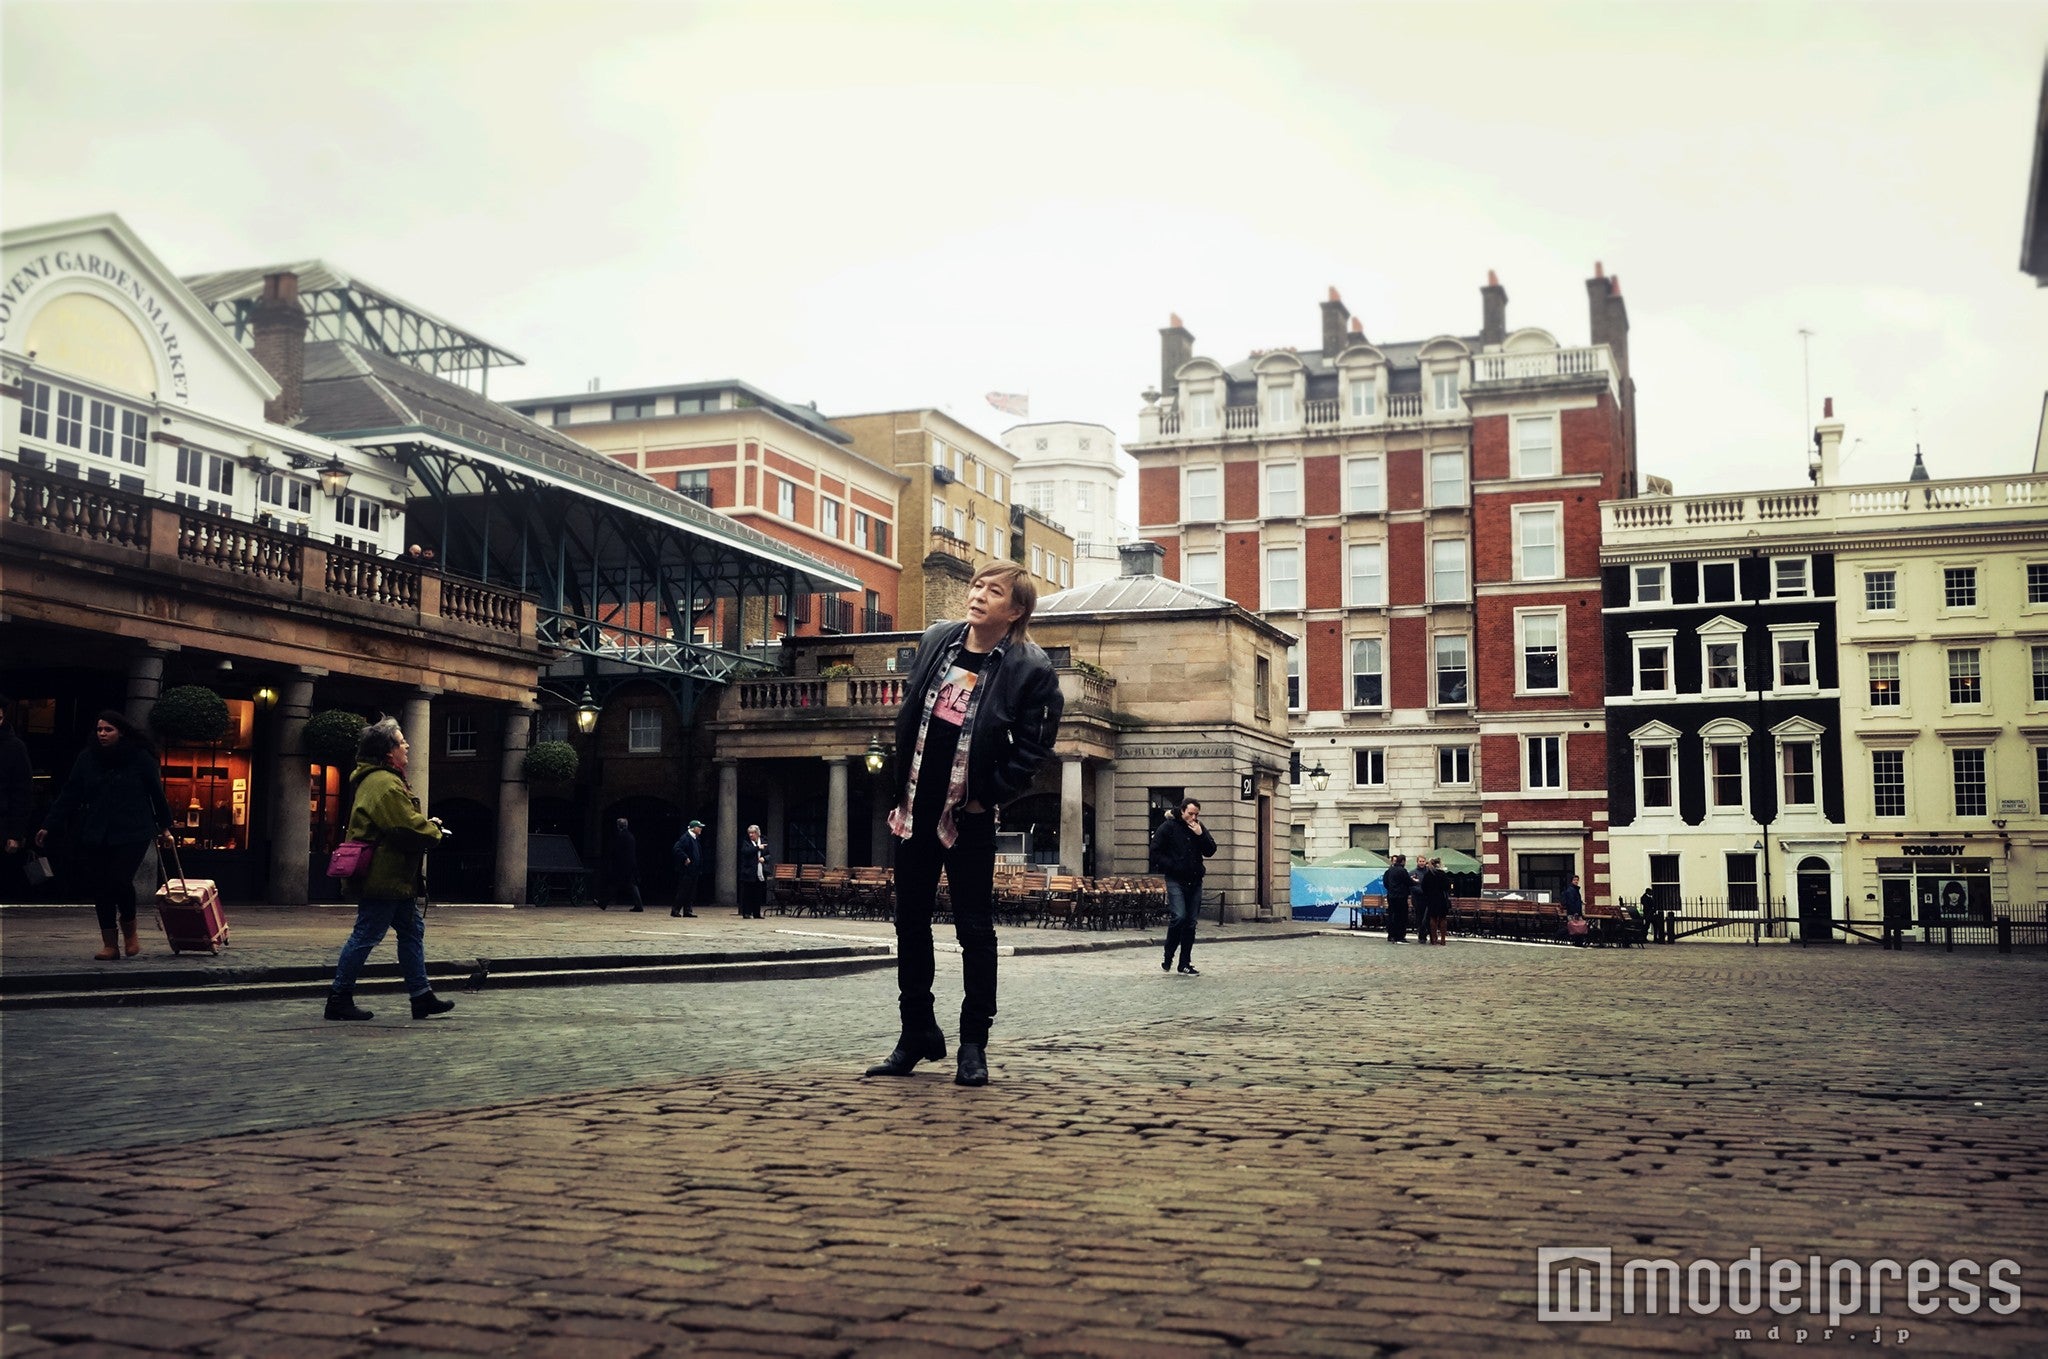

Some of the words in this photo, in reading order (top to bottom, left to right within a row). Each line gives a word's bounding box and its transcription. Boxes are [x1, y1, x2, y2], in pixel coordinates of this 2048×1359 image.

[55, 251, 144, 301] GARDEN
[142, 297, 188, 405] MARKET
[1243, 778, 1252, 794] 21
[1901, 845, 1966, 855] TONI&GUY
